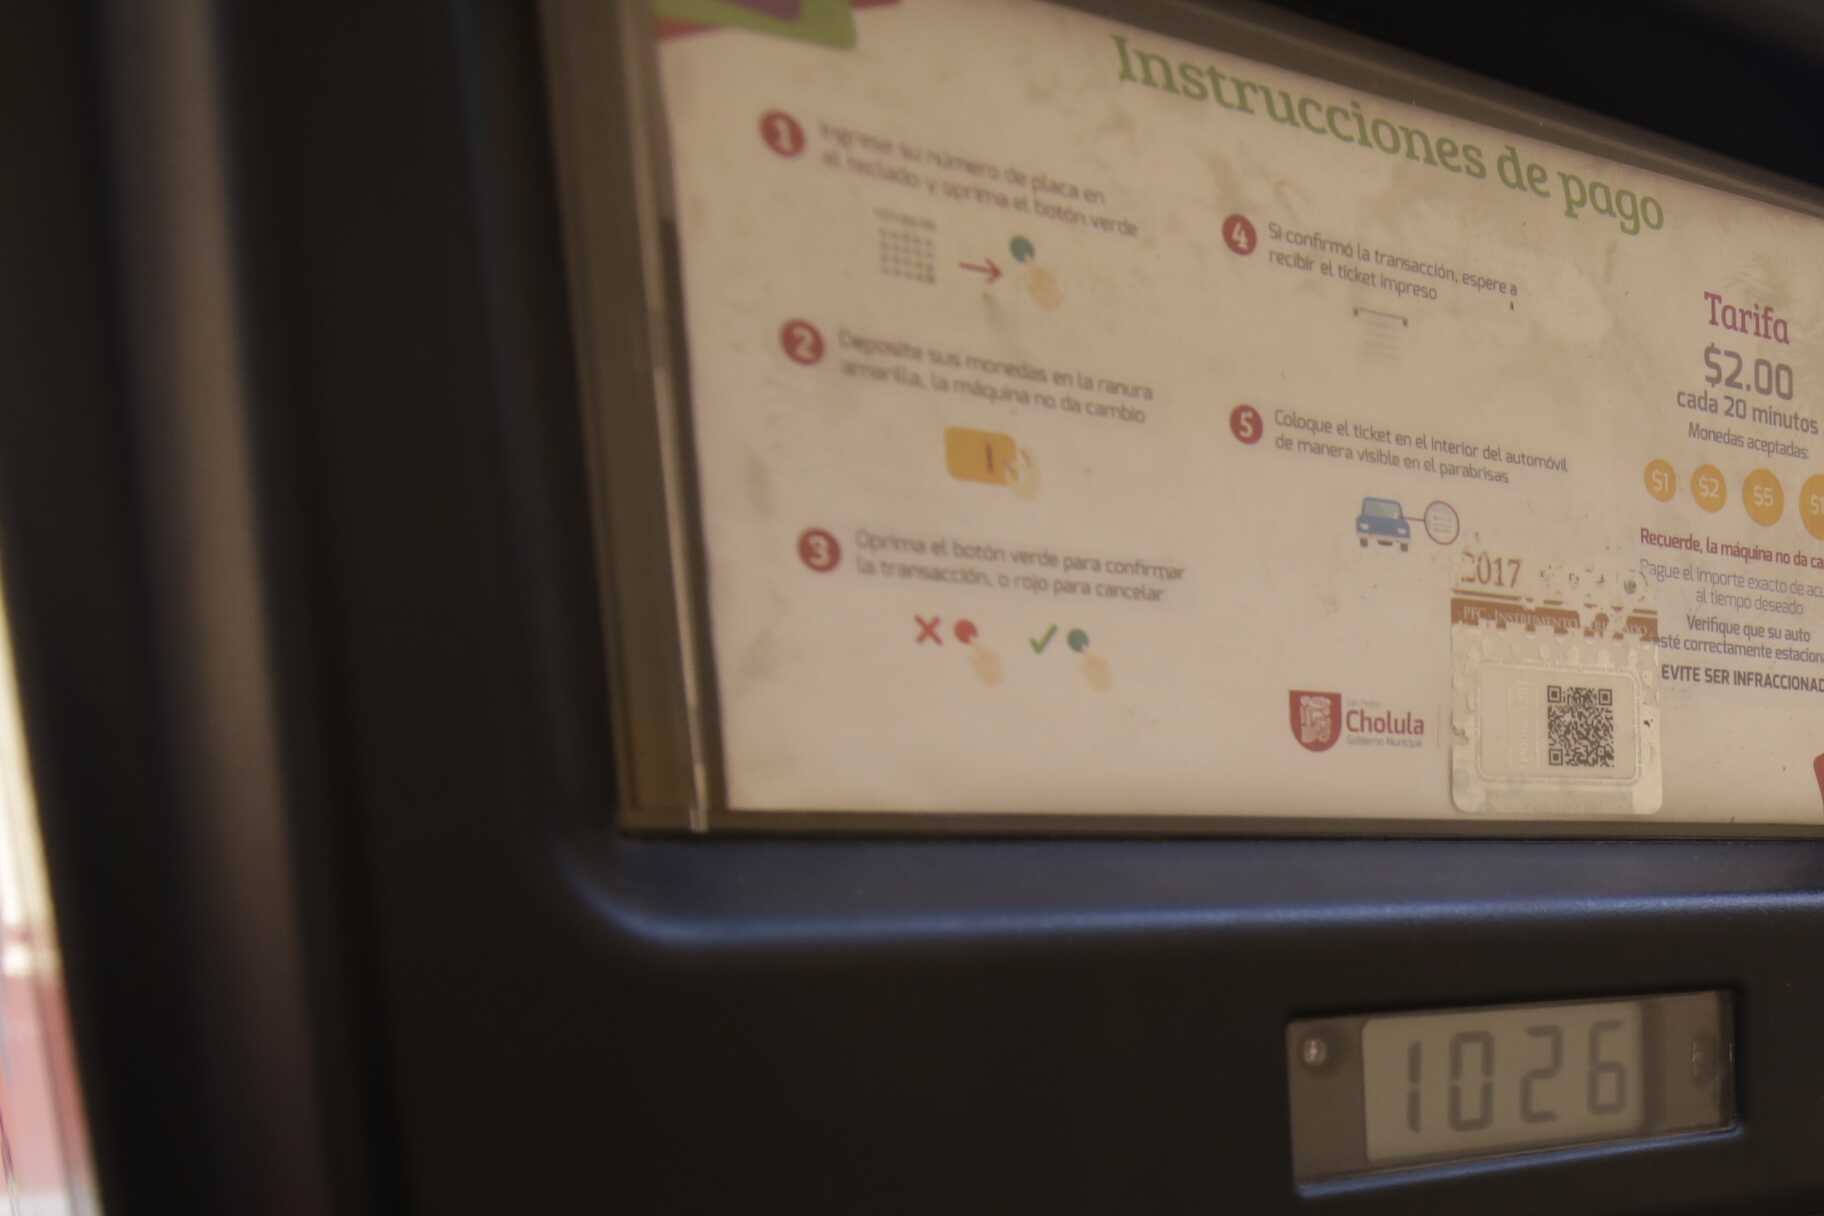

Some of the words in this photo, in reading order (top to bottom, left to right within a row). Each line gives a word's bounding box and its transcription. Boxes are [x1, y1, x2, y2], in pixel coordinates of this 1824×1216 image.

[1110, 33, 1486, 180] Instrucciones
[1498, 145, 1551, 198] de
[1558, 169, 1665, 236] pago
[926, 178, 937, 197] y
[1013, 192, 1032, 210] el
[1035, 197, 1086, 225] botón
[1090, 213, 1139, 236] verde
[1003, 166, 1028, 186] de
[1031, 175, 1080, 201] placa
[1083, 188, 1104, 203] en
[1268, 221, 1282, 240] Si
[1286, 230, 1354, 257] confirmó
[1357, 243, 1371, 262] la
[1374, 250, 1459, 284] transacción,
[1462, 272, 1507, 295] espere
[1510, 284, 1518, 297] a
[1269, 250, 1314, 272] recibir
[1320, 260, 1334, 278] el
[1338, 263, 1376, 287] ticket
[1380, 272, 1438, 300] impreso
[1704, 291, 1790, 345] Tarifa
[928, 348, 960, 367] sus
[965, 353, 1048, 384] monedas
[1053, 370, 1074, 387] en
[1078, 371, 1093, 391] la
[1097, 379, 1153, 400] ranura
[1704, 343, 1794, 400] $2.00
[931, 370, 950, 392] la
[953, 375, 1029, 407] máquina
[1034, 391, 1056, 410] no
[1060, 393, 1081, 413] da
[1085, 400, 1146, 424] cambio
[1677, 390, 1718, 414] cada
[1724, 395, 1747, 419] 20
[1752, 406, 1819, 435] minutos
[1274, 409, 1333, 436] Coloque
[1337, 420, 1350, 437] el
[1354, 423, 1392, 445] ticket
[1395, 433, 1412, 447] en
[1416, 434, 1430, 450] el
[1432, 436, 1479, 458] interior
[1482, 445, 1503, 462] del
[1506, 449, 1568, 474] automóvil
[1275, 434, 1294, 450] de
[1297, 439, 1353, 460] manera
[1357, 444, 1400, 467] visible
[1404, 457, 1421, 470] en
[1424, 457, 1437, 473] el
[1440, 461, 1509, 484] parabrisas
[1688, 422, 1745, 447] Monedas
[1747, 437, 1809, 459] aceptadas
[1652, 470, 1669, 493] $1
[1699, 476, 1720, 498] $2
[1754, 485, 1774, 507] $5
[855, 529, 926, 556] Oprima
[931, 538, 949, 557] el
[953, 539, 1005, 564] botón
[1009, 547, 1060, 569] verde
[1063, 556, 1101, 576] para
[1105, 557, 1186, 581] confirmar
[1641, 528, 1703, 554] Recuerde,
[1706, 537, 1718, 555] la
[1721, 541, 1773, 564] máquina
[1776, 551, 1791, 565] no
[1793, 551, 1807, 567] da
[856, 557, 875, 576] la
[880, 560, 993, 587] transacción,
[998, 574, 1009, 588] o
[1013, 573, 1048, 594] rojo
[1052, 578, 1091, 597] para
[1095, 582, 1165, 601] cancelar
[1640, 558, 1680, 582] Pague
[1683, 565, 1694, 580] el
[1697, 566, 1745, 586] importe
[1748, 575, 1787, 593] exacto
[1789, 579, 1804, 595] de
[1696, 588, 1707, 603] al
[1710, 590, 1752, 610] tiempo
[1754, 596, 1804, 615] deseado
[1683, 638, 1772, 659] correctamente
[1686, 614, 1740, 640] Verifique
[1743, 624, 1765, 641] que
[1768, 627, 1783, 640] su
[1785, 628, 1810, 642] auto
[1661, 664, 1700, 682] EVITE
[1704, 668, 1730, 685] SER
[1346, 709, 1425, 736] Cholula
[1407, 1019, 1627, 1135] 1026
